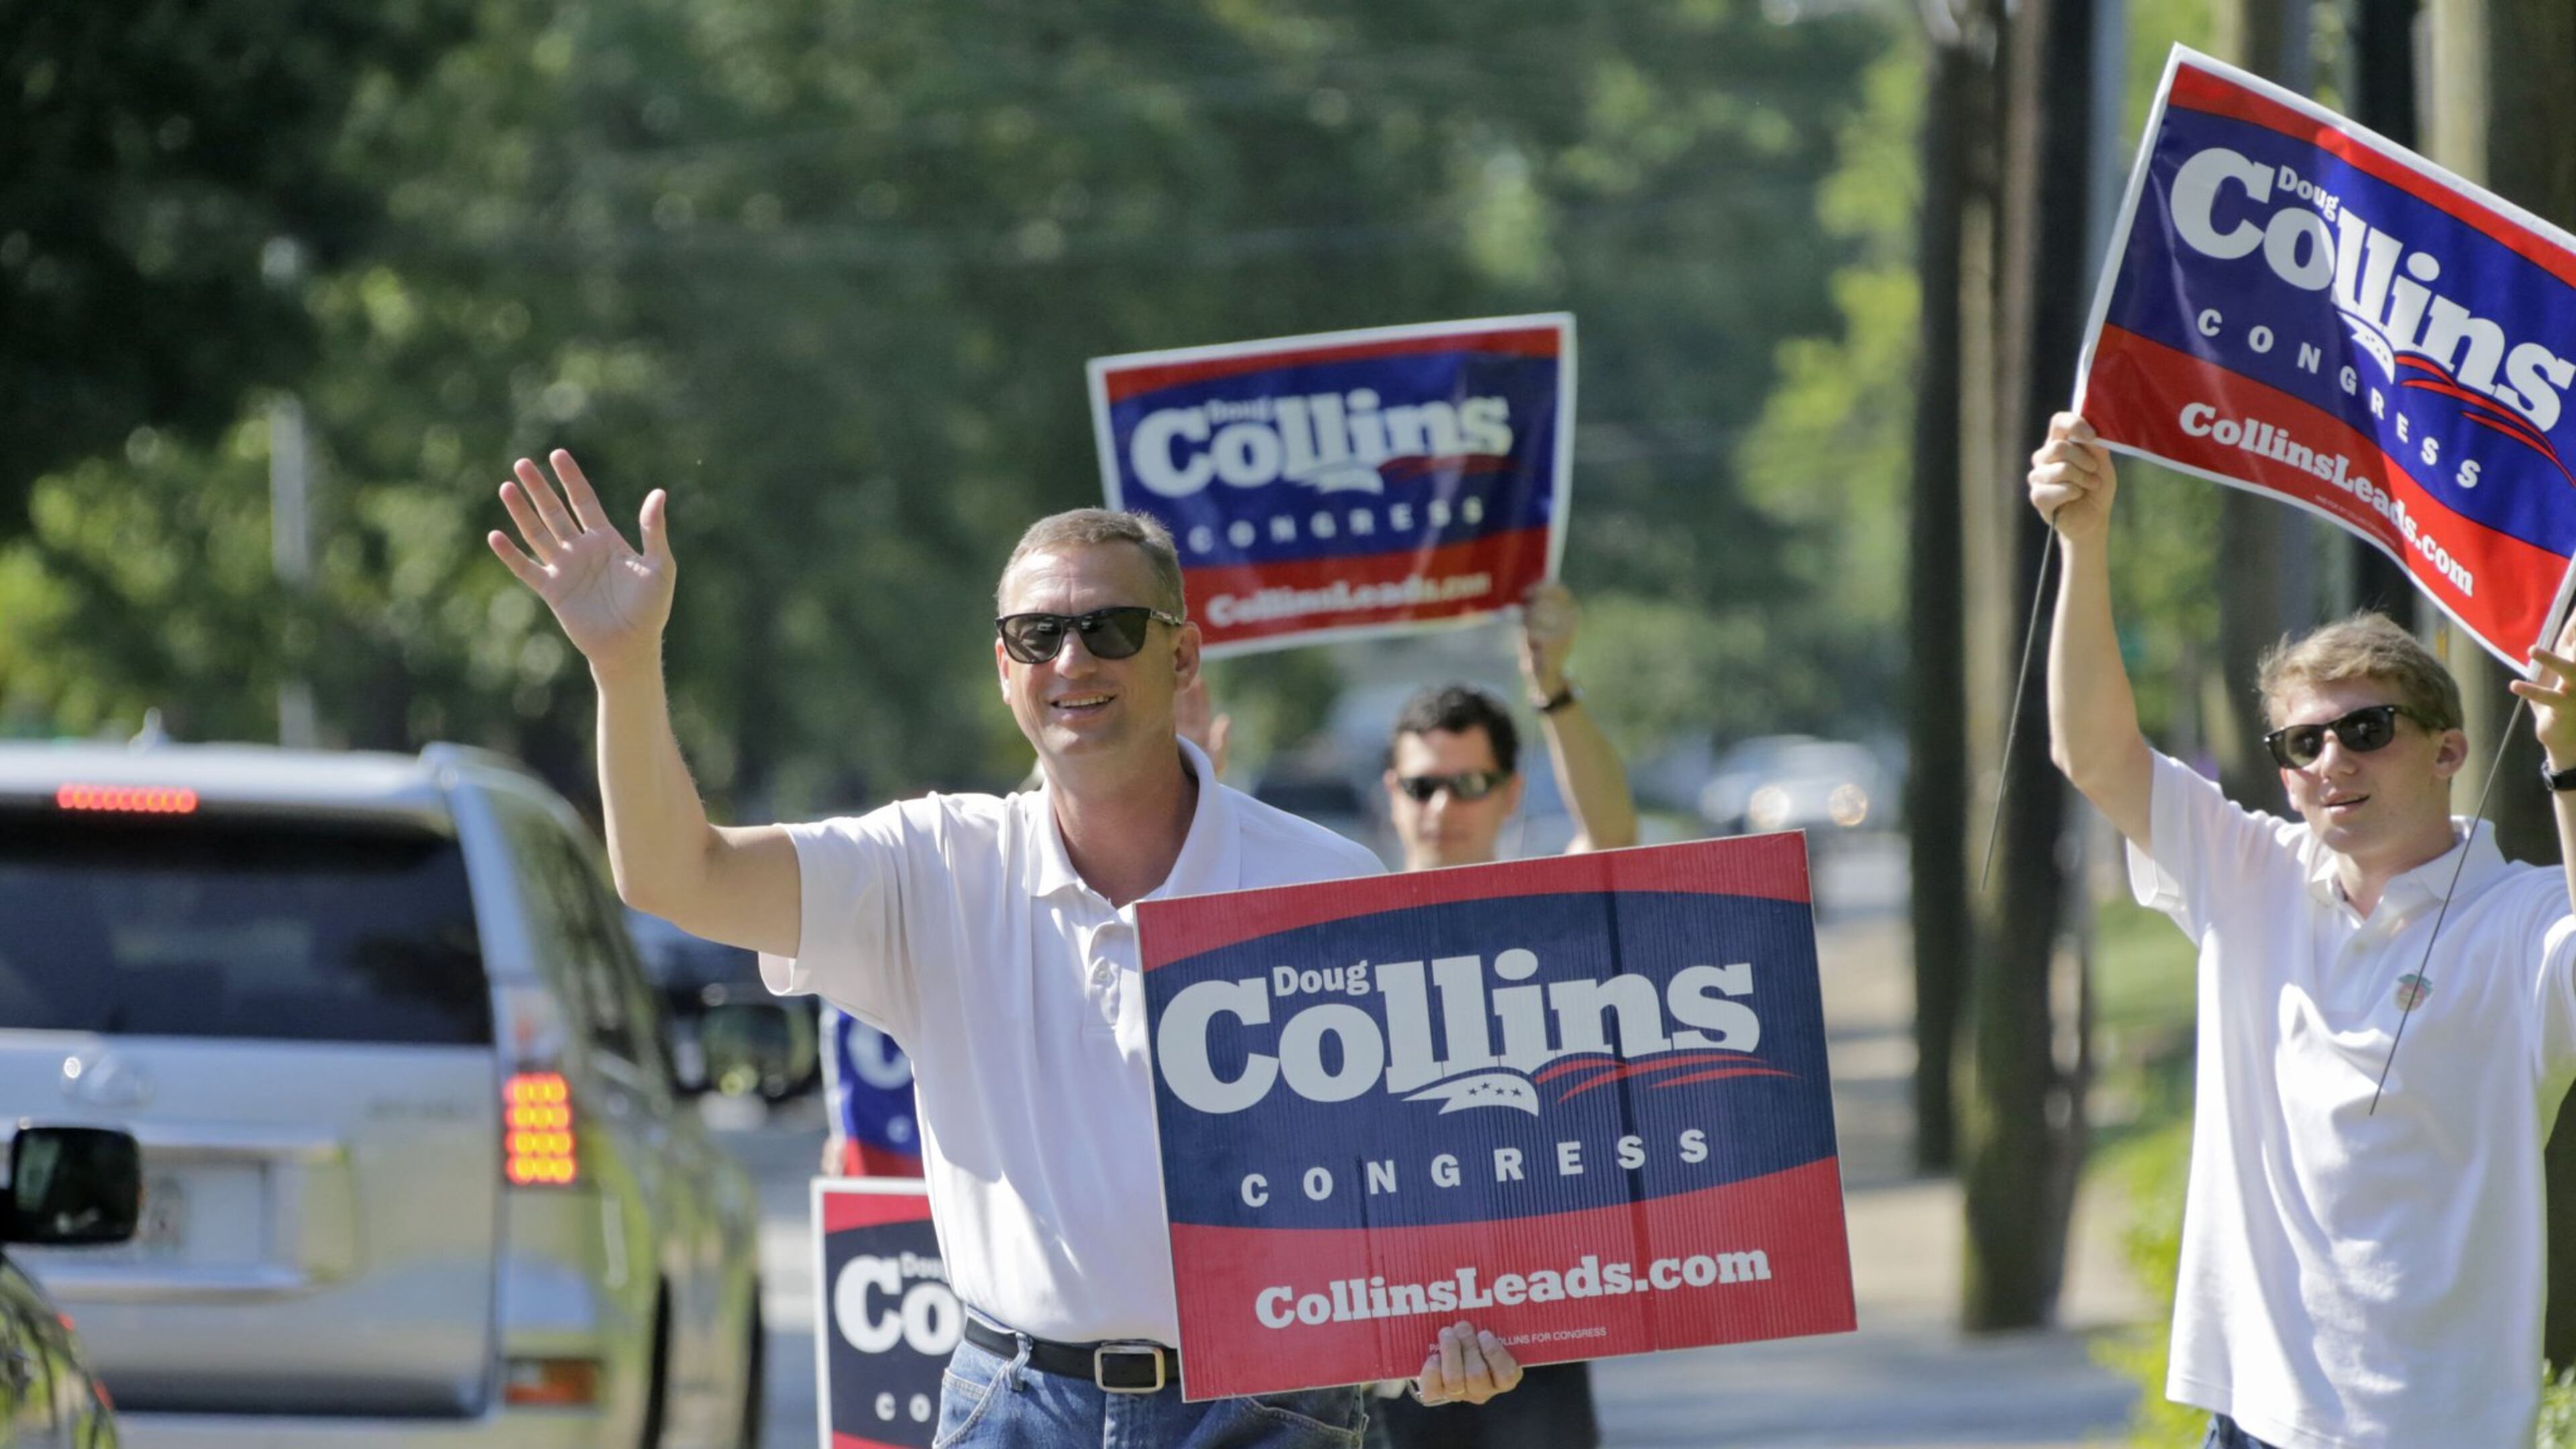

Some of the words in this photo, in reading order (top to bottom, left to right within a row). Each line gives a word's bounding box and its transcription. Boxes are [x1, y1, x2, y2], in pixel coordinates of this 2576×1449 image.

[2277, 165, 2339, 222] Doug
[2170, 147, 2576, 432] Collins
[2198, 309, 2481, 488] CONGRESS
[1130, 388, 1513, 498] Collins
[1188, 496, 1483, 555] CONGRESS
[2180, 402, 2474, 597] CollinsLeads.com
[1273, 959, 1371, 997] Doug
[1157, 948, 1760, 1114] Collins
[1241, 1130, 1708, 1207] CONGRESS
[1255, 1248, 1771, 1329] CollinsLeads.com
[1497, 1334, 1530, 1346] OLLINS
[1532, 1332, 1551, 1344] FOR
[1553, 1327, 1607, 1340] CONGRESS
